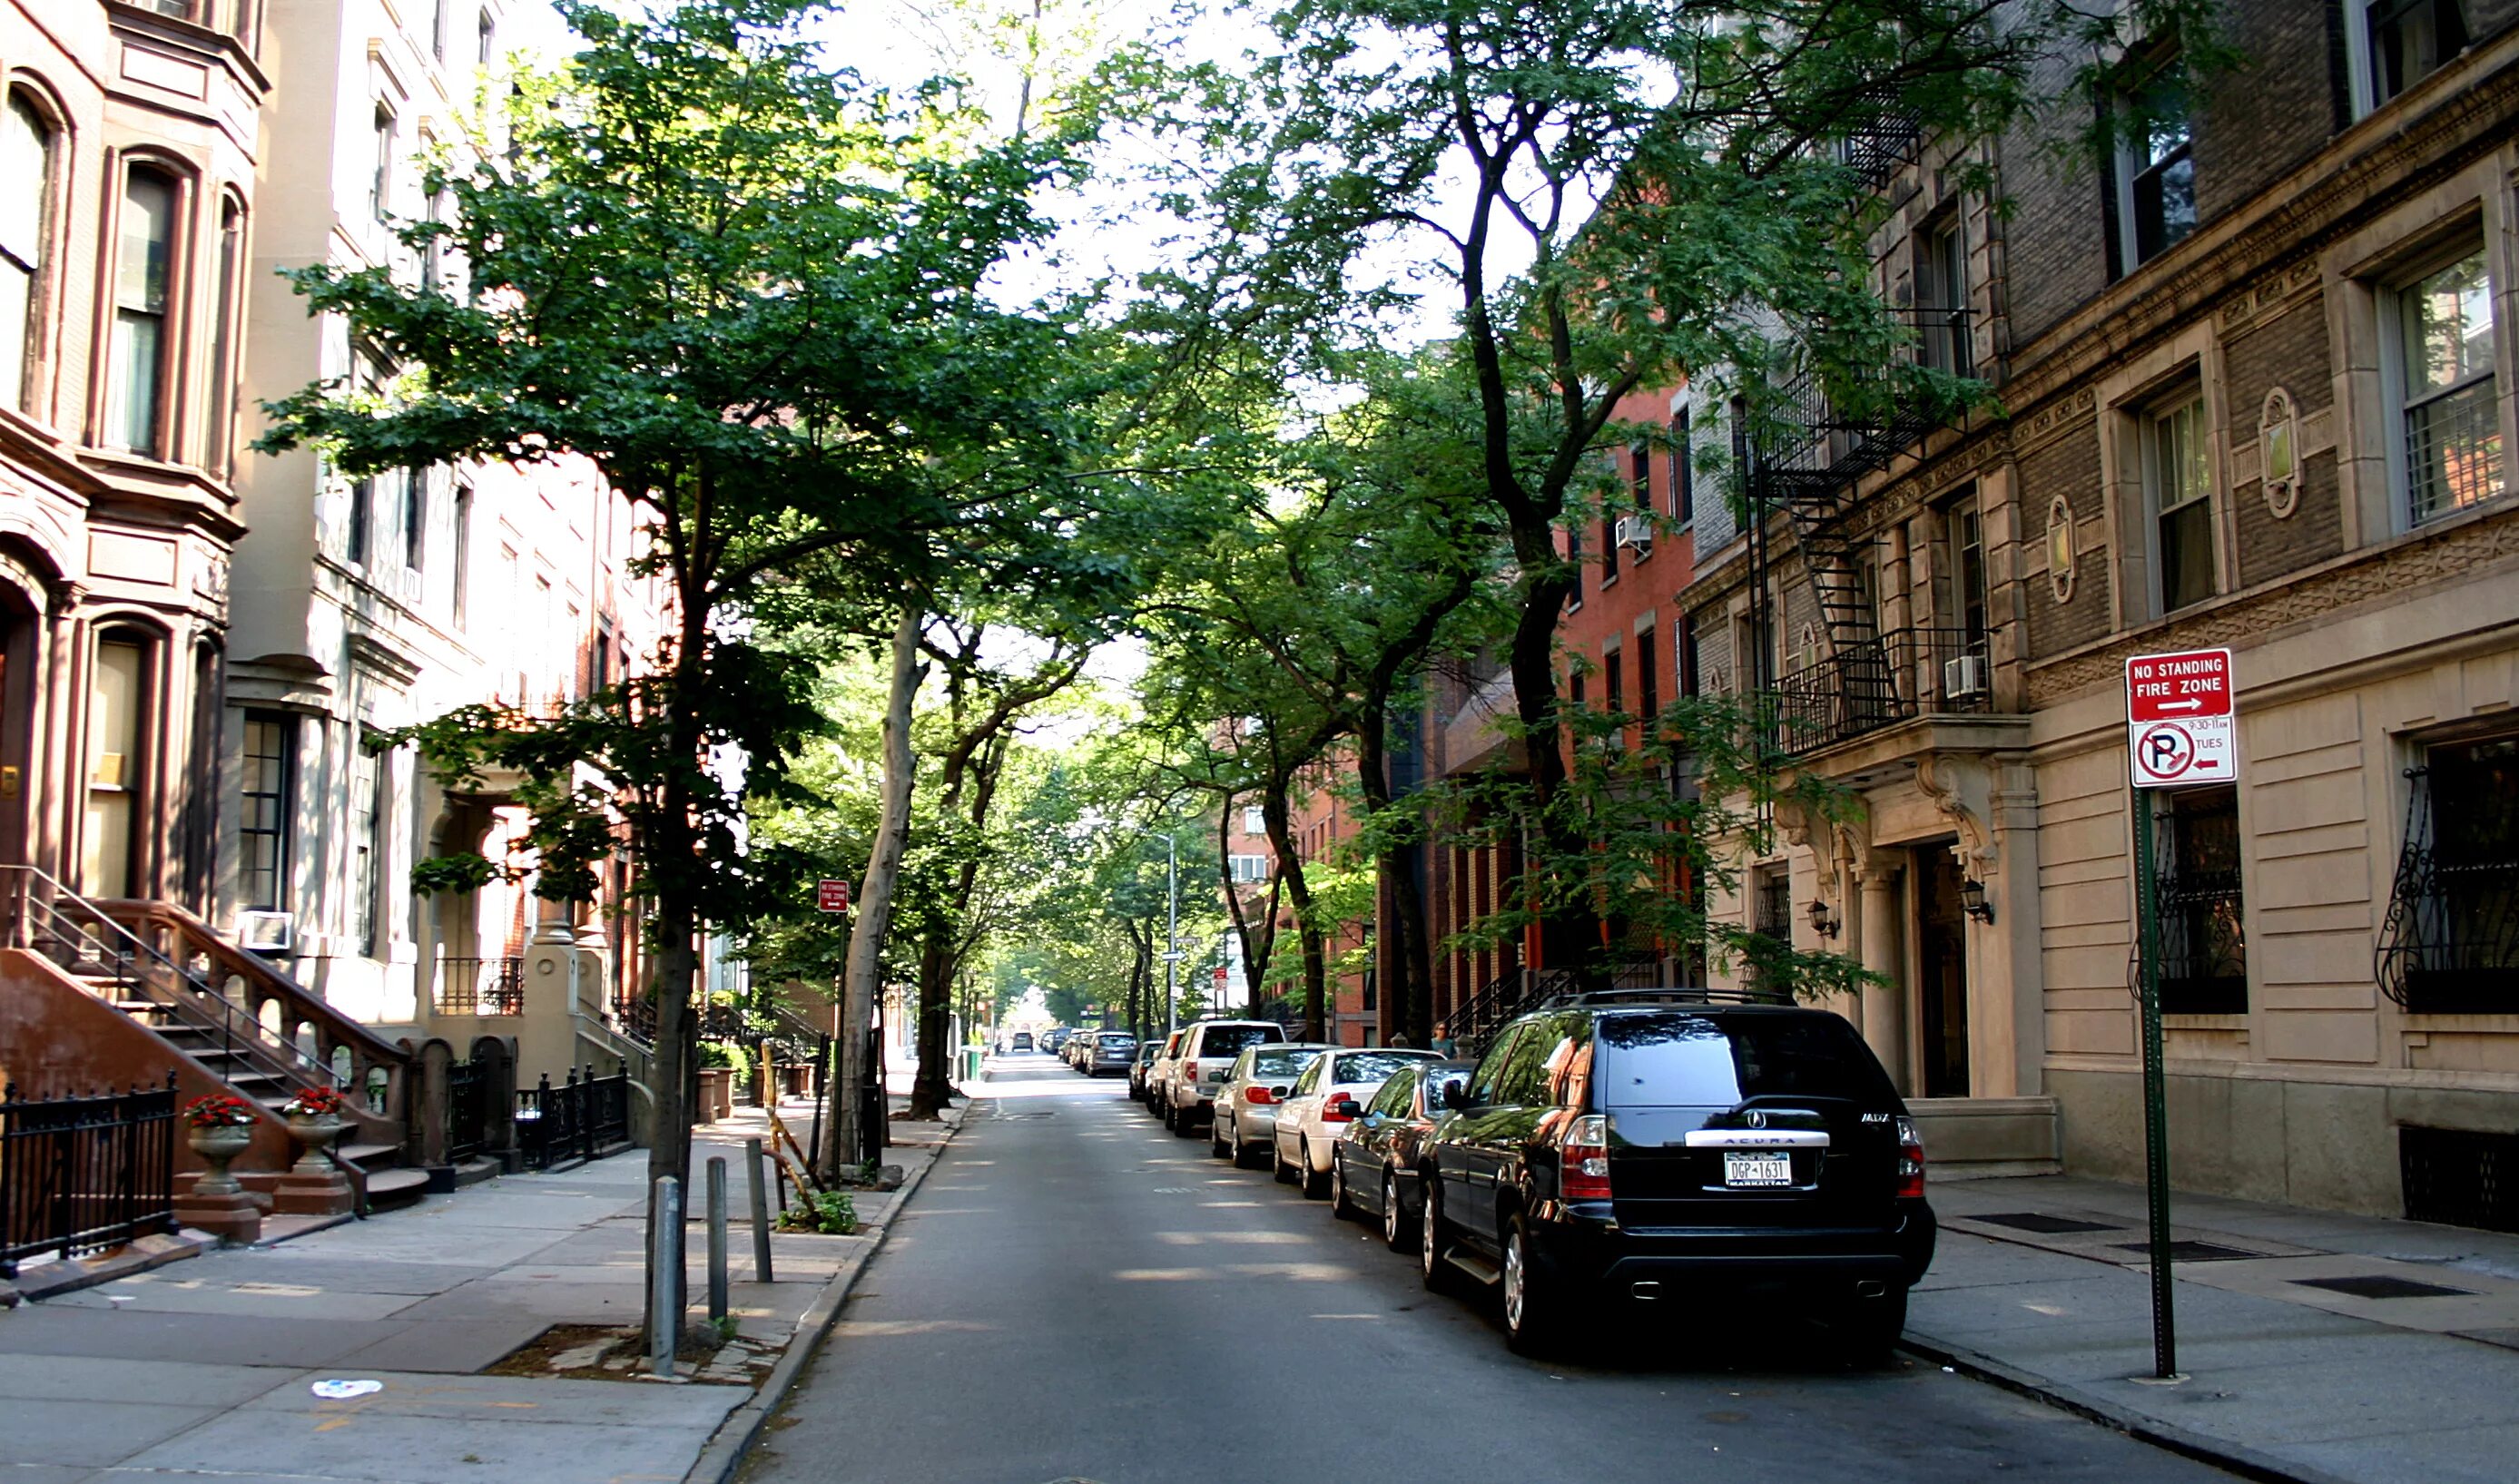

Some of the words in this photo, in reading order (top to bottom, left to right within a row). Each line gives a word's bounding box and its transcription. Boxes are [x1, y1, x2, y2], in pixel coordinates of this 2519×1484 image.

[2134, 665, 2152, 679] NO
[2159, 658, 2222, 677] STANDING
[2137, 682, 2170, 697] FIRE
[2180, 677, 2222, 693] ZONE
[2196, 738, 2222, 750] TUES
[1861, 1113, 1890, 1123] MDX
